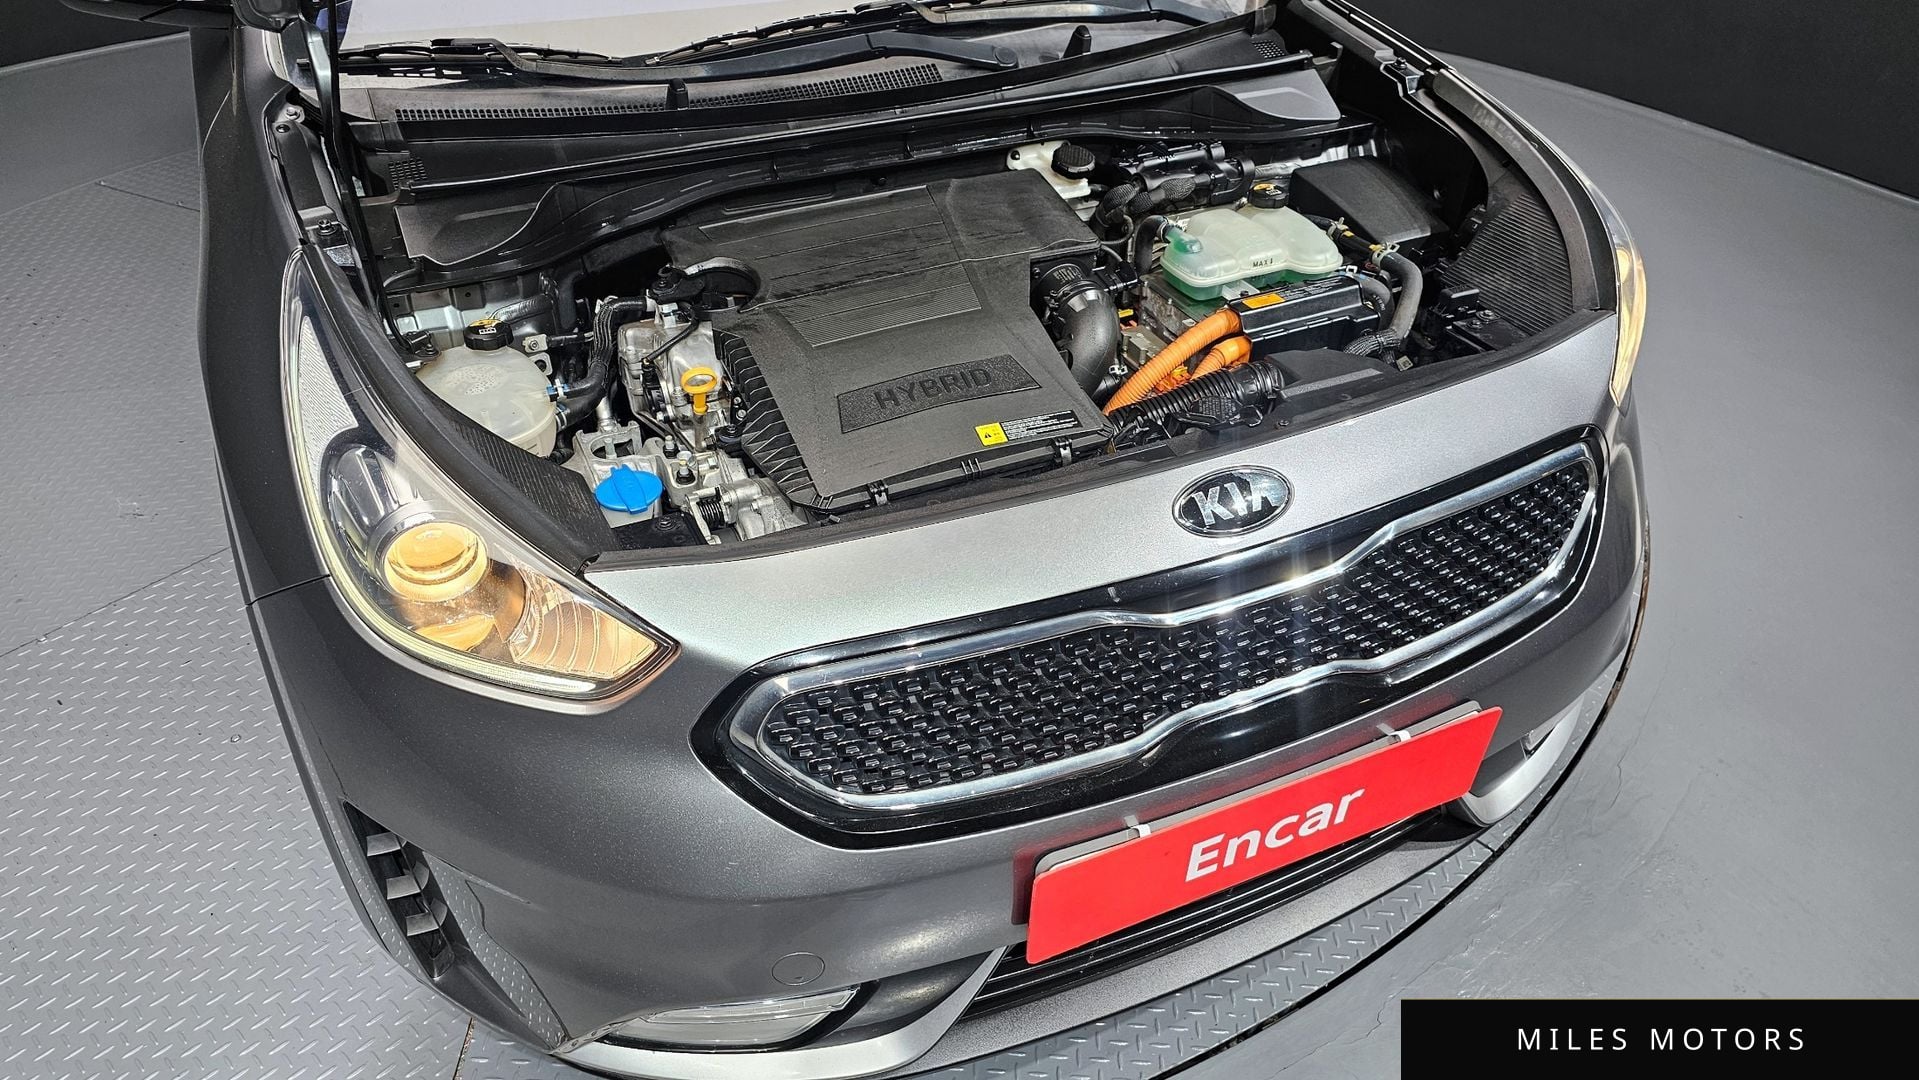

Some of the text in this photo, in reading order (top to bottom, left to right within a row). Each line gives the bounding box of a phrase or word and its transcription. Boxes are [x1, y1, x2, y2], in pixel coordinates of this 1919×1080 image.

[1253, 259, 1268, 267] MAX
[874, 368, 992, 409] HYBRID
[1192, 479, 1280, 525] KIA
[1185, 788, 1365, 882] Encar
